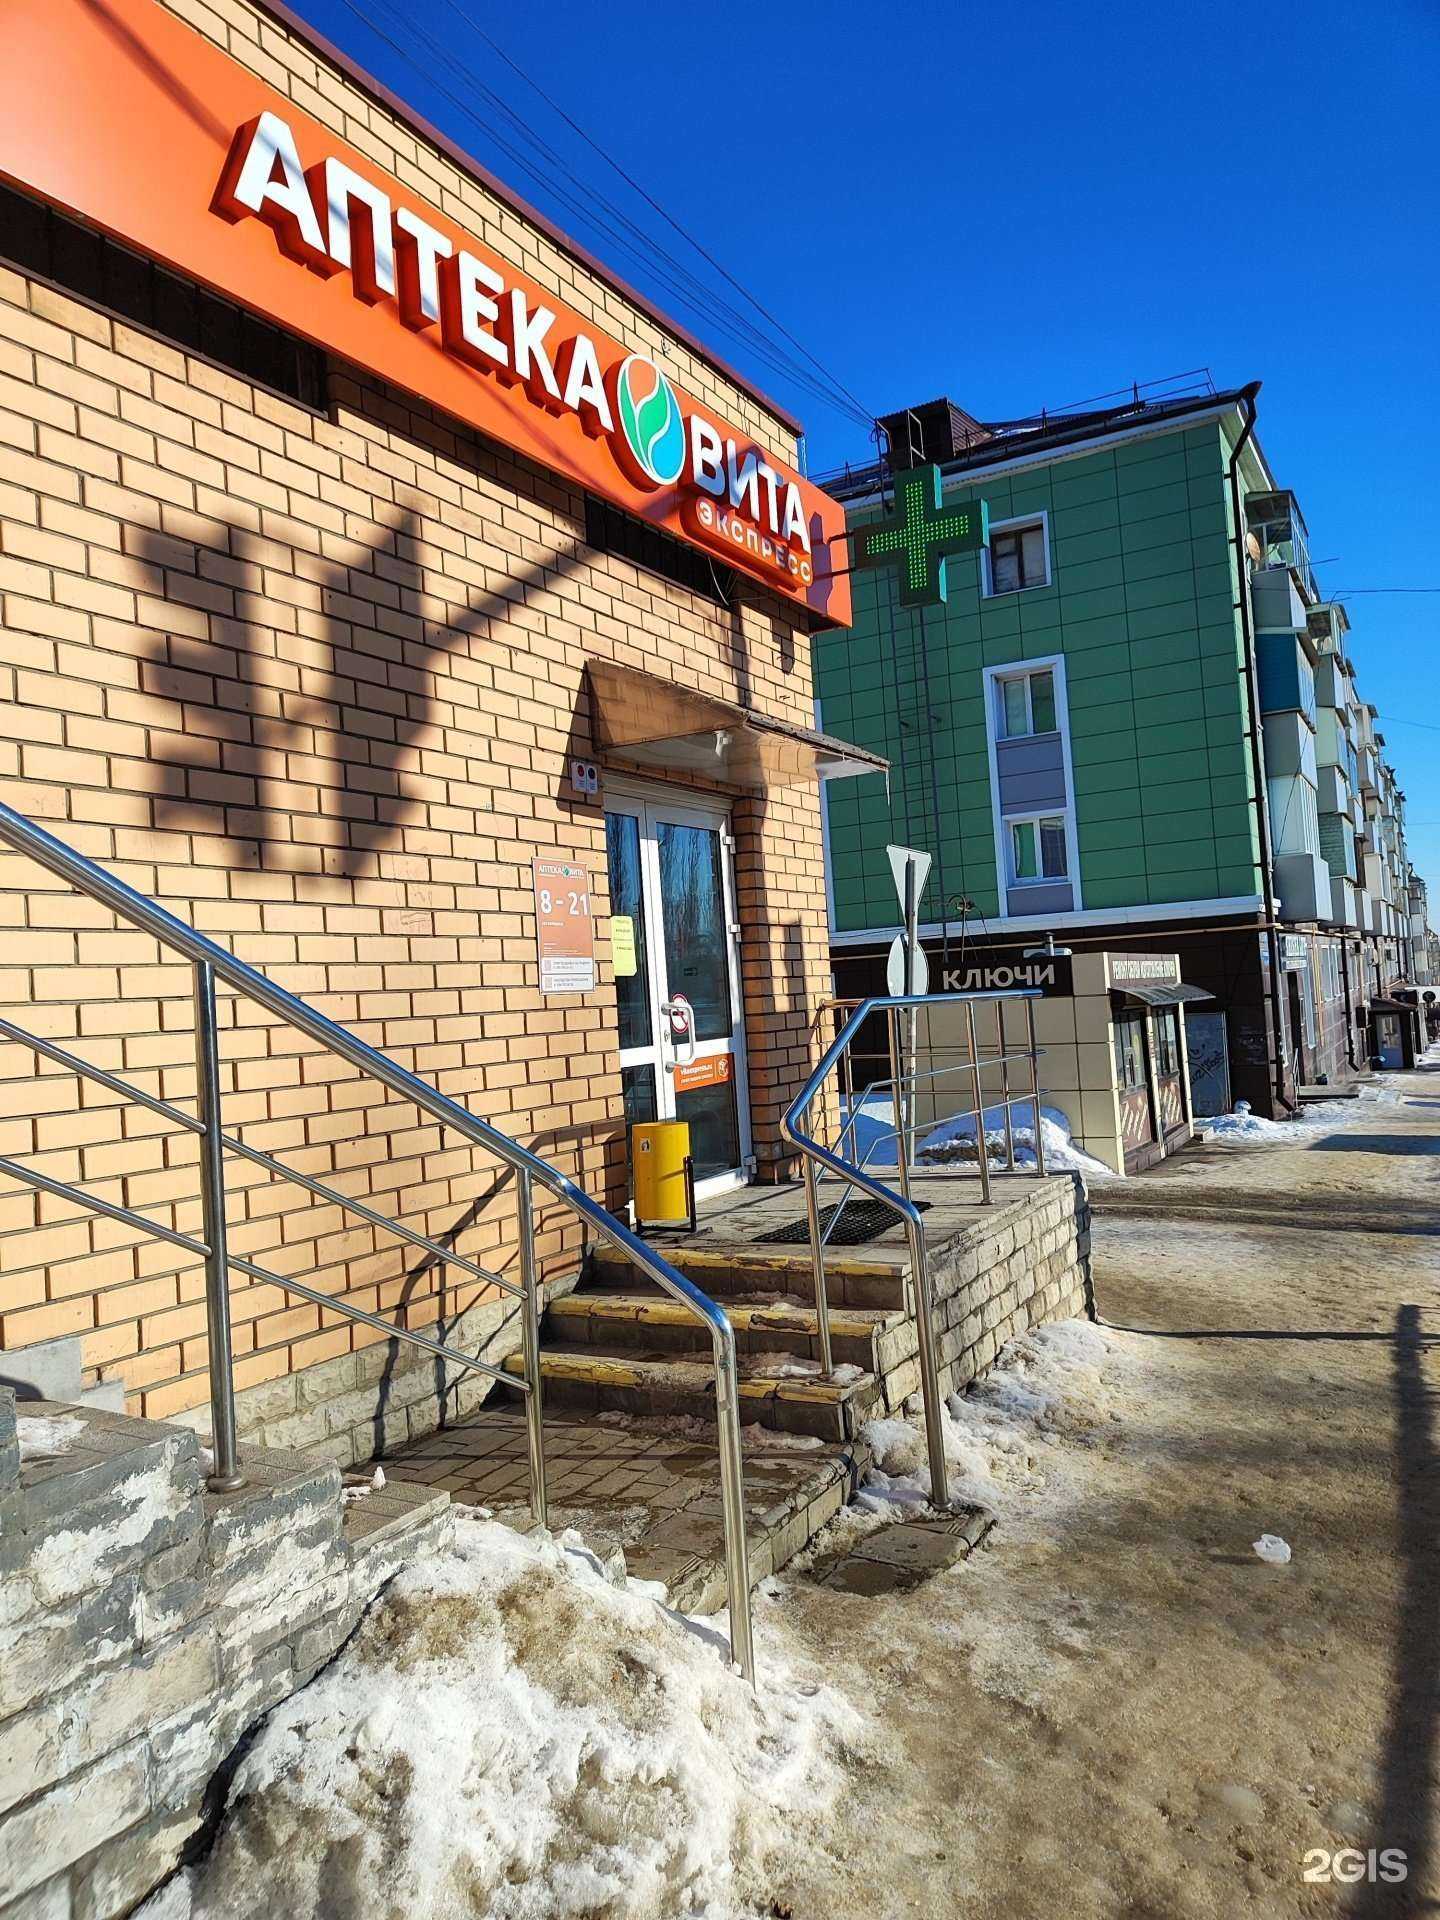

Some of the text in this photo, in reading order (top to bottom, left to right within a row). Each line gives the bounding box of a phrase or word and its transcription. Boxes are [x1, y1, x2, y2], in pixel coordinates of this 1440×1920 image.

[232, 110, 812, 554] АПТЕКА ВИТА
[698, 500, 812, 583] ЭКСПРЕСС
[540, 889, 553, 914] 8
[567, 891, 588, 916] 21
[942, 964, 1056, 990] КЛЮЧИ
